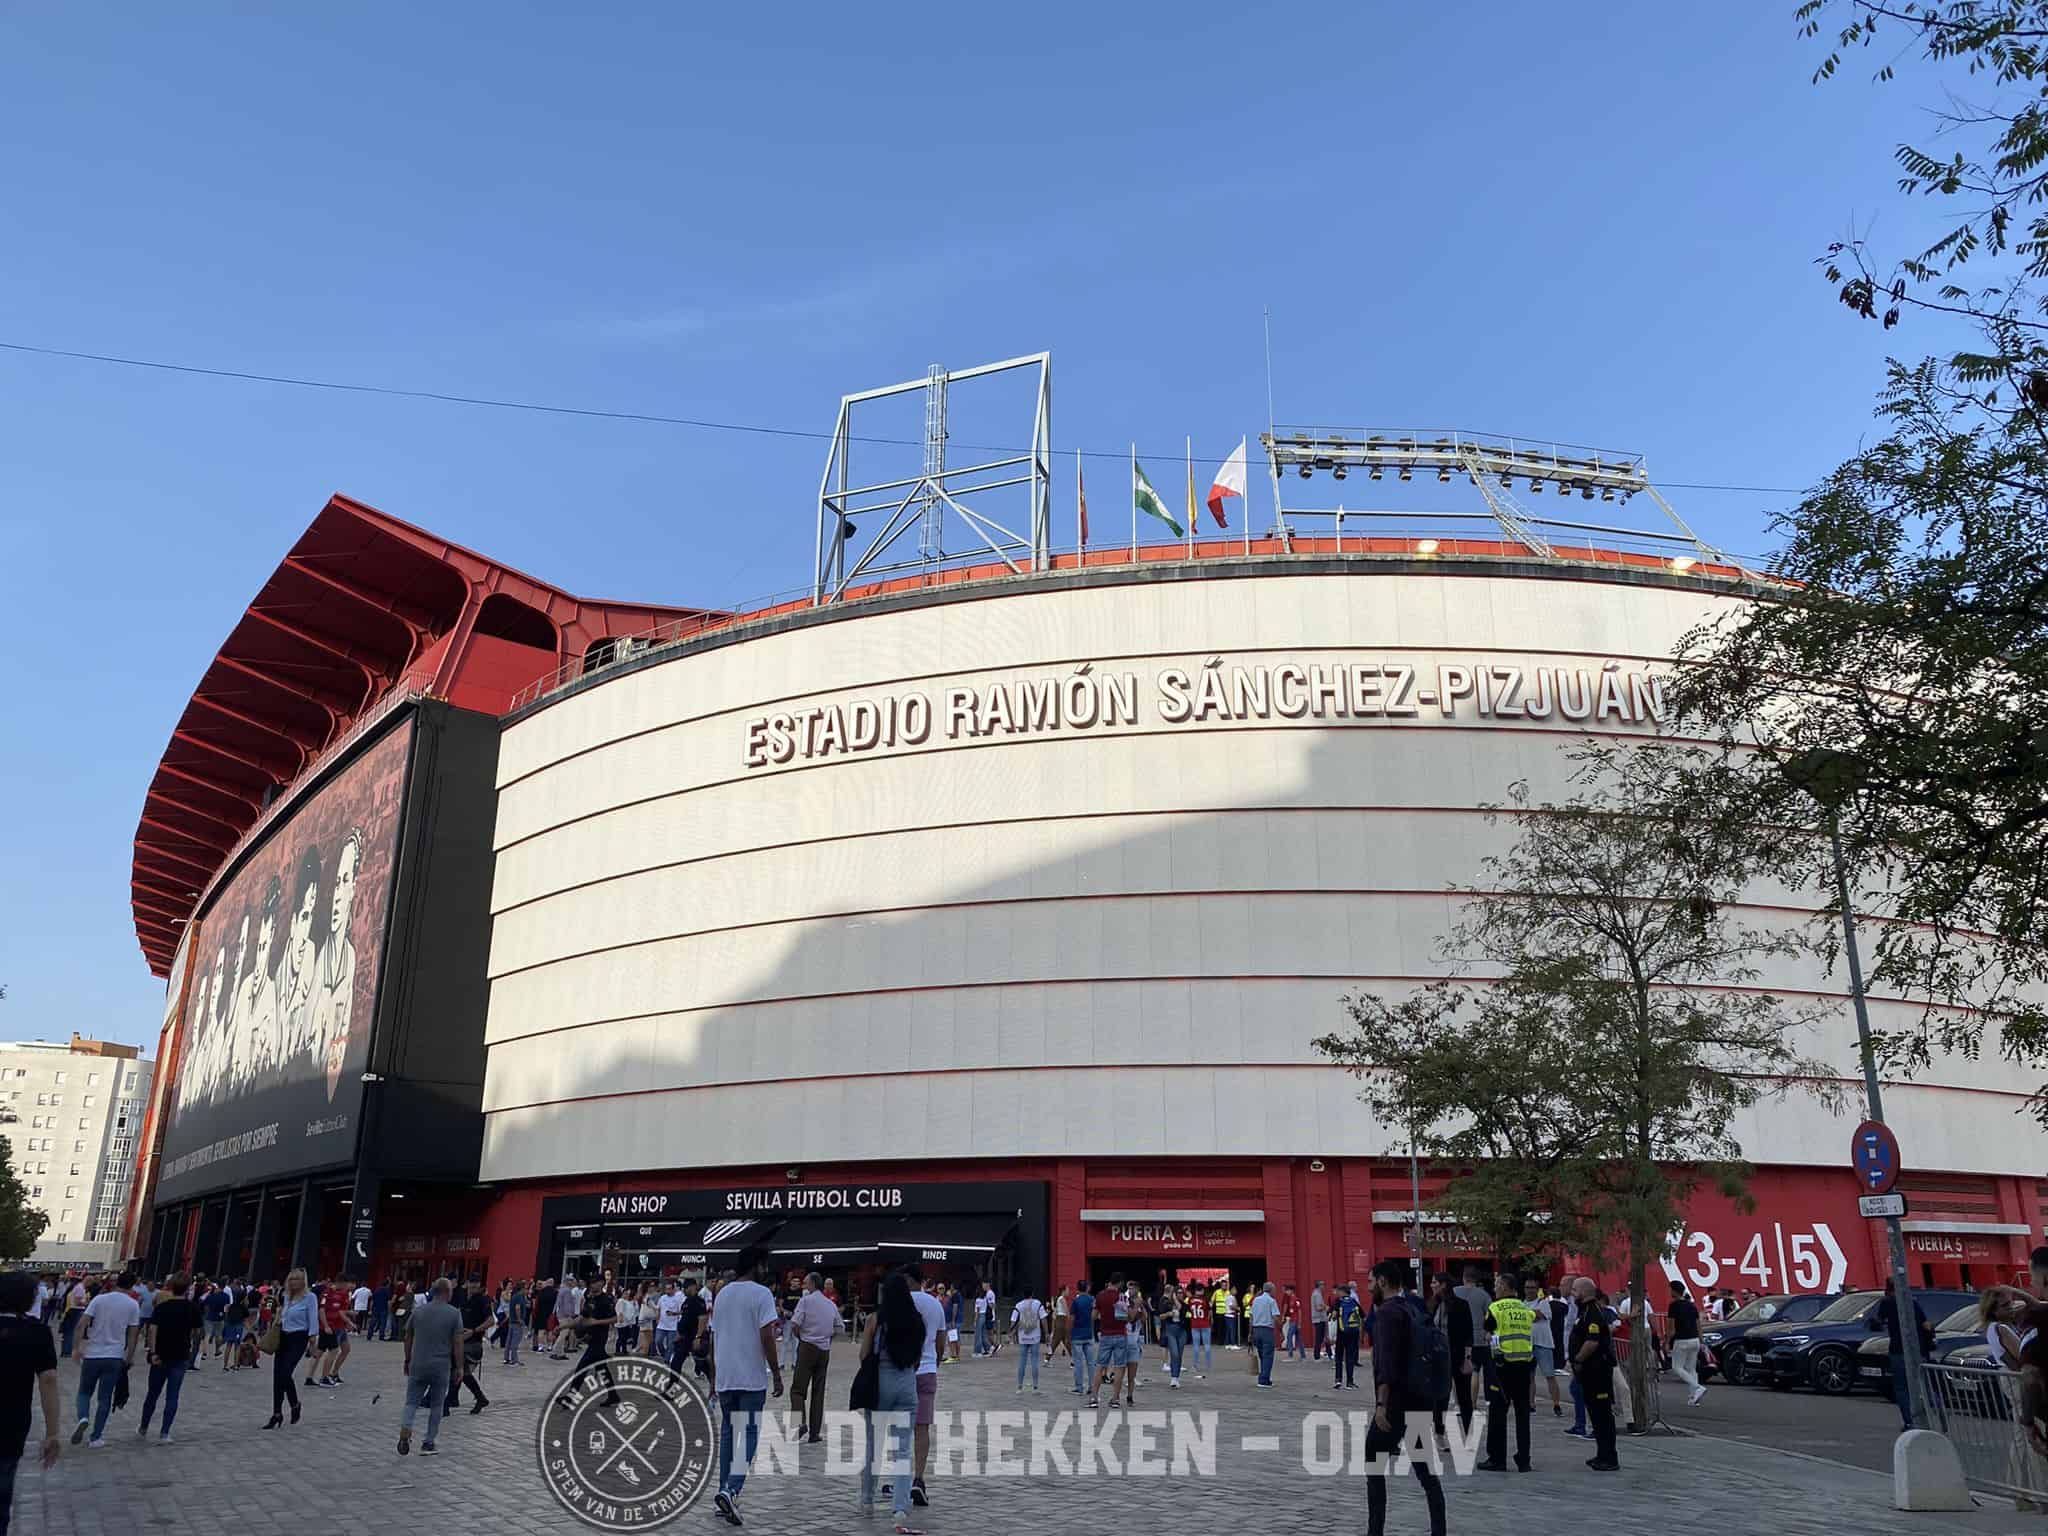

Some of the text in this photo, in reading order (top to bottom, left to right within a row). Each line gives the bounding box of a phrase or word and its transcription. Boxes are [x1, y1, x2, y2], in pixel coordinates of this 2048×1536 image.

[743, 655, 1666, 768] ESTADIO RAMÓN SÁNCHEZ-PIZJUÁN
[600, 1195, 668, 1215] FAN SHOP
[726, 1188, 902, 1210] SEVILLA FUTBOL CLUB
[1111, 1224, 1194, 1241] PUERTA 3
[1402, 1227, 1469, 1244] PERTA
[1910, 1236, 1951, 1251] PUERTA
[1955, 1239, 1963, 1252] 5
[681, 1255, 707, 1264] NUNCA
[813, 1254, 824, 1264] SE
[922, 1250, 948, 1261] RINDE
[1191, 1304, 1205, 1319] 16
